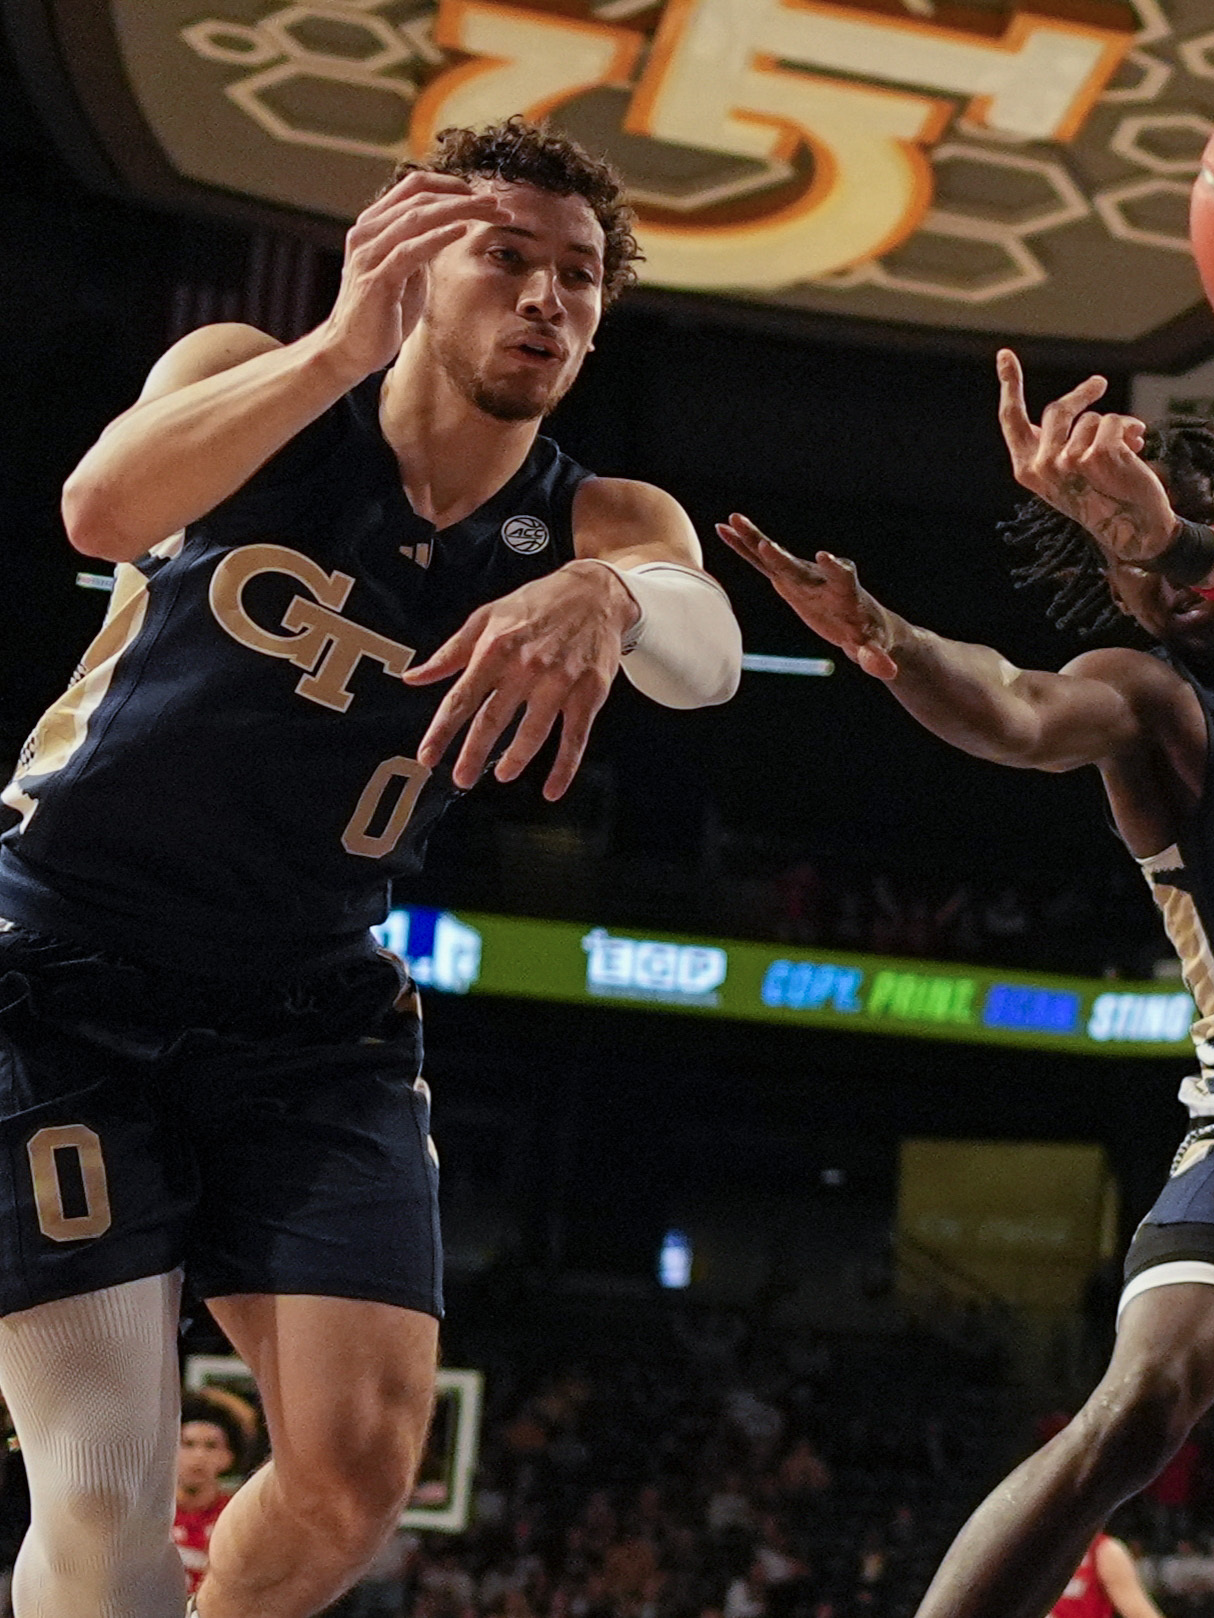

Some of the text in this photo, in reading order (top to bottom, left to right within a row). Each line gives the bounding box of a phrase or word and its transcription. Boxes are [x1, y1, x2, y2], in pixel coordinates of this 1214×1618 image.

[507, 527, 546, 539] ACC
[209, 543, 417, 714] GT
[341, 756, 433, 859] 0
[26, 1123, 112, 1243] 0
